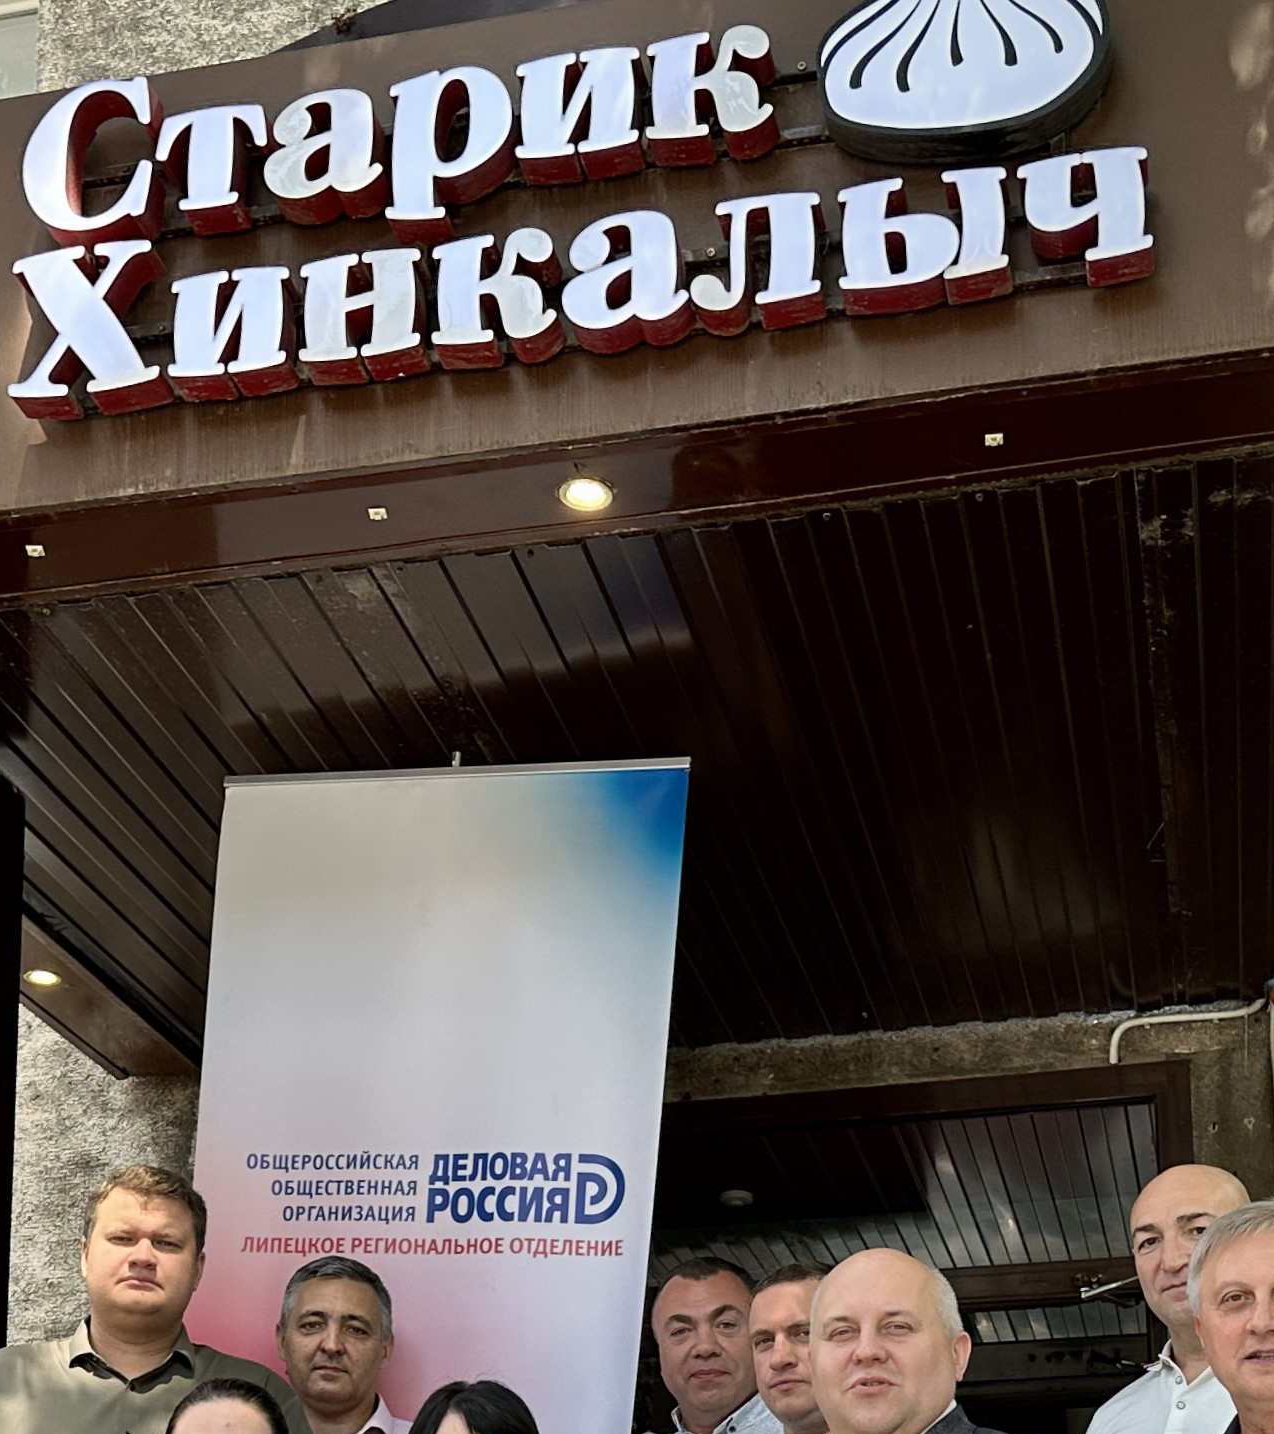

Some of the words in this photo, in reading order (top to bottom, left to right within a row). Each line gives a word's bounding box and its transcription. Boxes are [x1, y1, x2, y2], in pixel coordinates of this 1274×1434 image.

[22, 24, 777, 220] Старик
[7, 146, 1156, 400] Хинкалыч
[246, 1151, 419, 1173] ОБЩЕРОССИЙСКАЯ
[428, 1152, 572, 1186] ДЕЛОВАЯ
[271, 1179, 417, 1198] ОБЩЕСТВЕННАЯ
[282, 1205, 416, 1225] ОРГАНИЗАЦИЯ
[426, 1185, 570, 1224] РОССИЯ
[240, 1236, 345, 1256] ЛИПЕЦКОЕ
[350, 1237, 504, 1255] РЕГИОНАЛЬНОЕ
[509, 1237, 624, 1259] ОТДЕЛЕНИЕ
